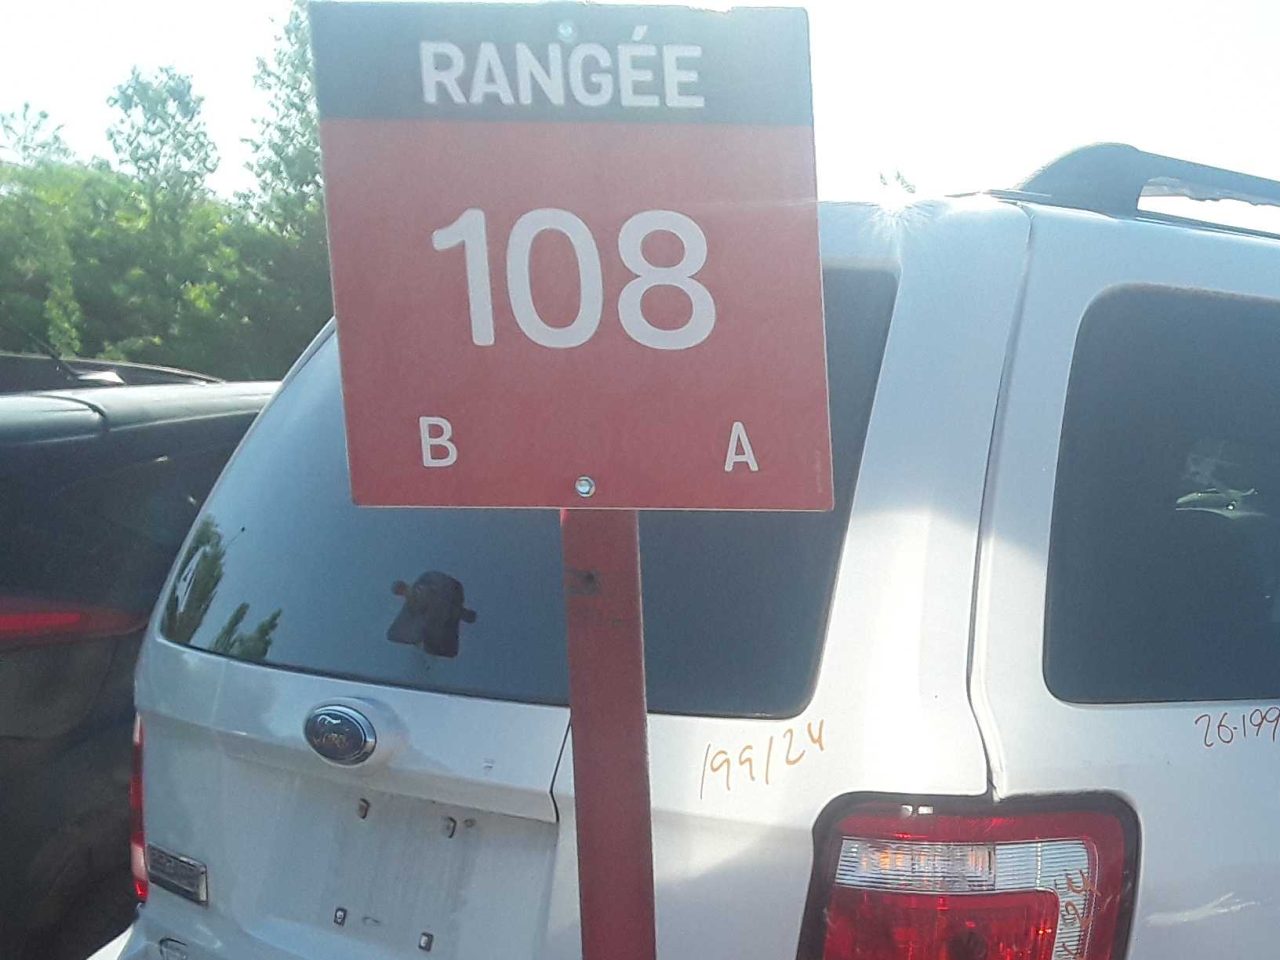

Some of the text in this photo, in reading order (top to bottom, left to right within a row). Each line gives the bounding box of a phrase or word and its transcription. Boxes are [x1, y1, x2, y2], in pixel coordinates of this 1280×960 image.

[419, 25, 705, 108] RANGÉE
[432, 208, 716, 350] 108
[418, 416, 458, 468] B
[724, 421, 759, 472] A
[700, 719, 825, 800] 199124
